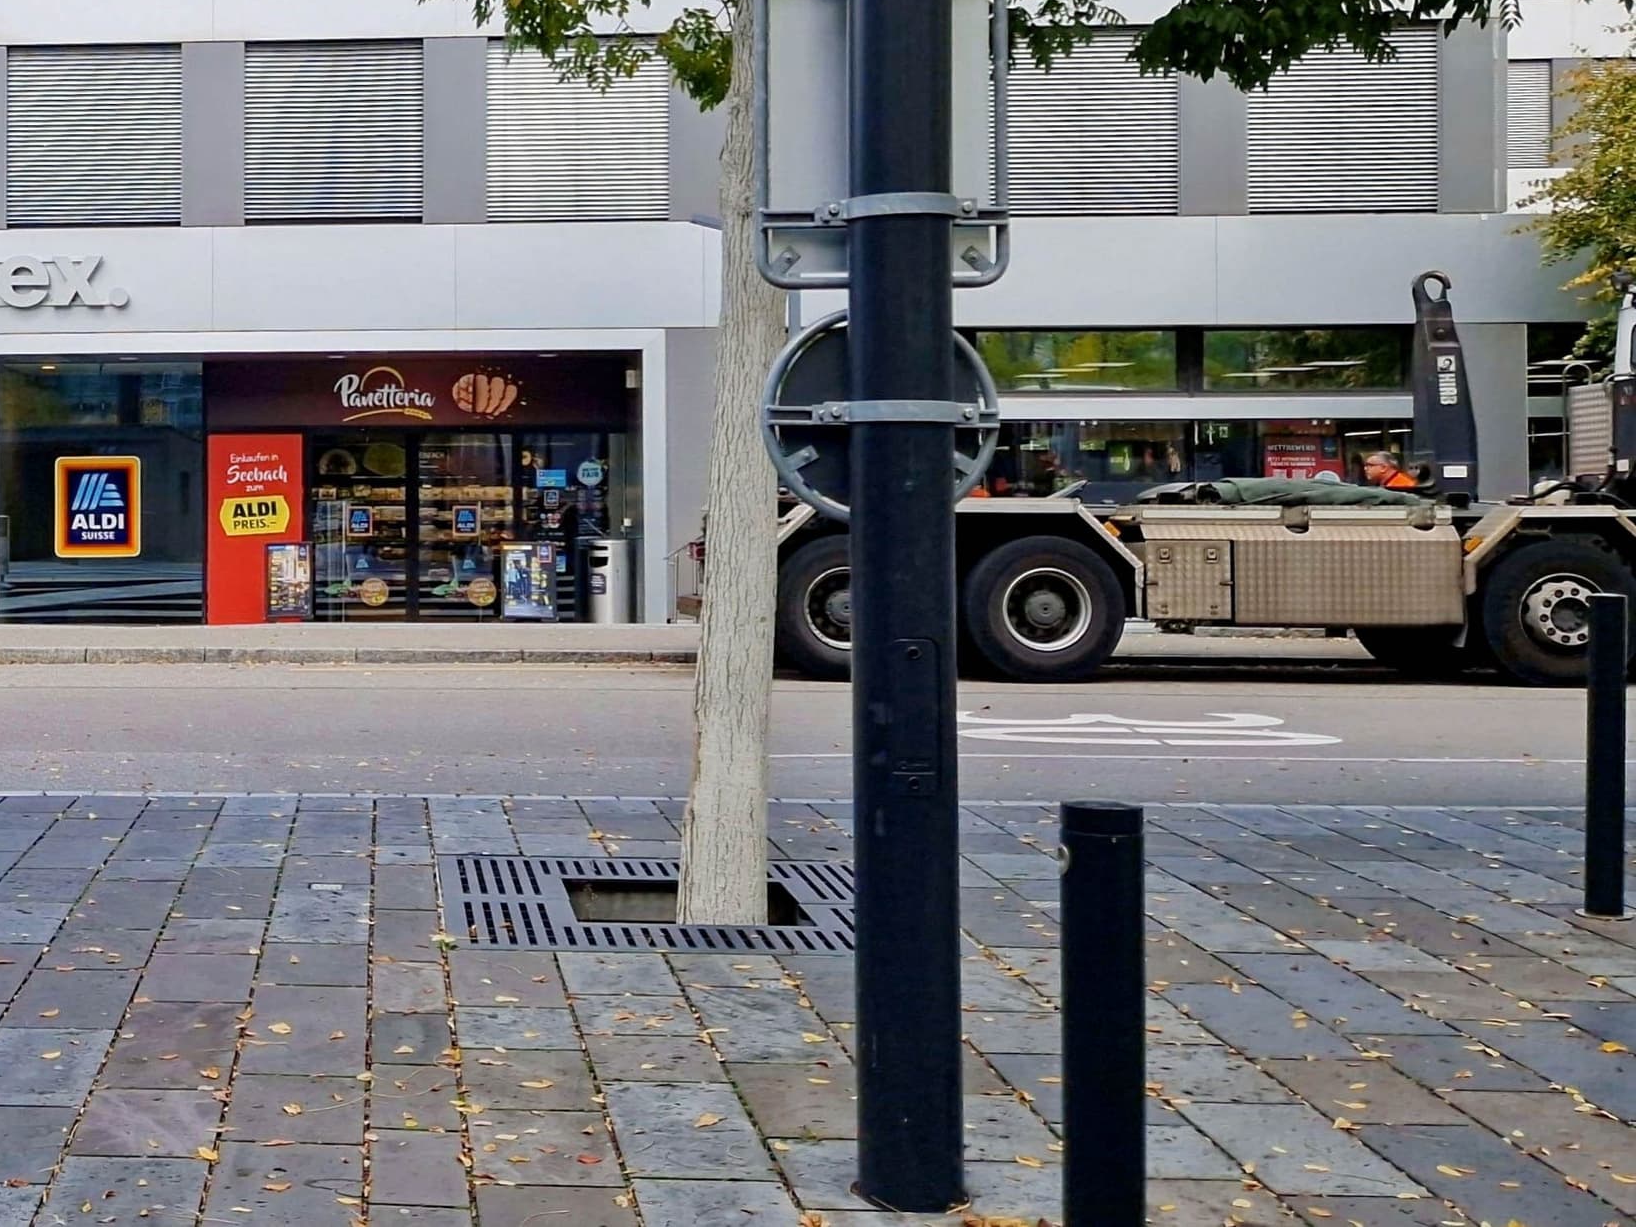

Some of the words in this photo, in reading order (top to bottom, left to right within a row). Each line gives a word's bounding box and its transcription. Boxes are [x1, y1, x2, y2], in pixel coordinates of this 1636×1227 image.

[333, 373, 437, 408] Panetteria
[230, 452, 269, 464] Einkaufen
[271, 454, 279, 462] in
[226, 465, 288, 484] Seebach
[245, 484, 264, 492] zum
[232, 501, 277, 519] ALDI
[70, 513, 125, 530] ALDI
[81, 531, 116, 540] SUISSE
